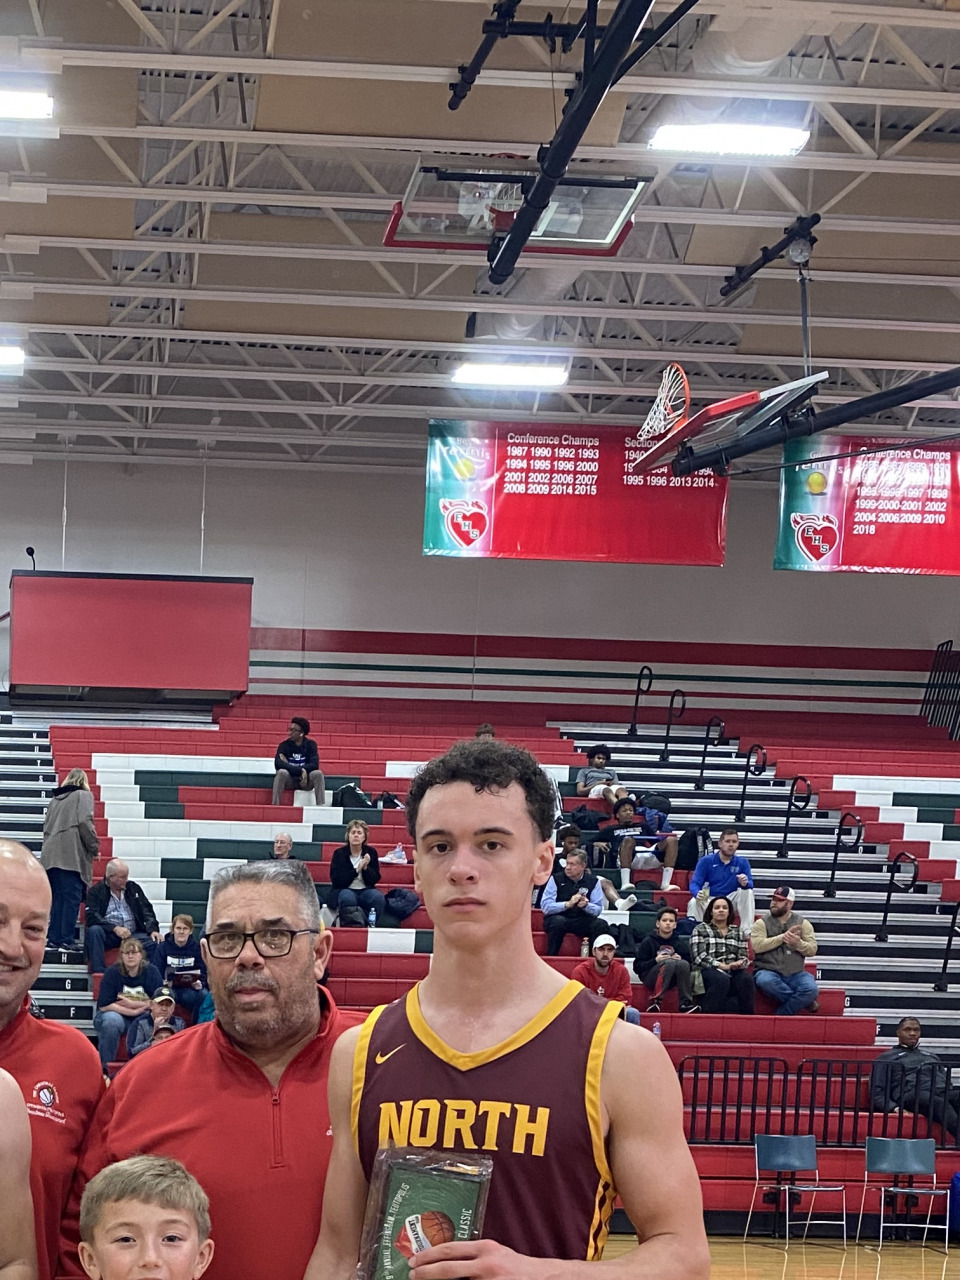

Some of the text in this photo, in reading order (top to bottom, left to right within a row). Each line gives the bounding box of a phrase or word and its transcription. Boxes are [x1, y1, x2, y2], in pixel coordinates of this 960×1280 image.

[507, 433, 599, 447] Conference Champs
[507, 446, 599, 459] 1987 1990 1992 1993
[913, 449, 951, 460] Champs
[506, 459, 598, 472] 1994 1995 1996 2000
[504, 472, 597, 485] 2001 2002 2006 2007
[623, 475, 715, 488] 1995 1996 2013 2014
[504, 484, 597, 495] 2008 2009 2014 2015
[904, 488, 924, 498] 1997
[927, 489, 948, 499] 1998
[855, 499, 947, 512] 1999 2000 2001 2002
[854, 512, 876, 522] 2004
[900, 514, 922, 524] 2009
[923, 515, 945, 524] 2010
[853, 525, 876, 534] 2018
[62, 954, 67, 963] H
[816, 970, 822, 980] H
[66, 980, 71, 990] G
[845, 997, 850, 1007] G
[70, 1008, 75, 1017] F
[876, 1025, 881, 1035] F
[379, 1099, 550, 1157] NORTH
[458, 1208, 472, 1239] CLASSIC
